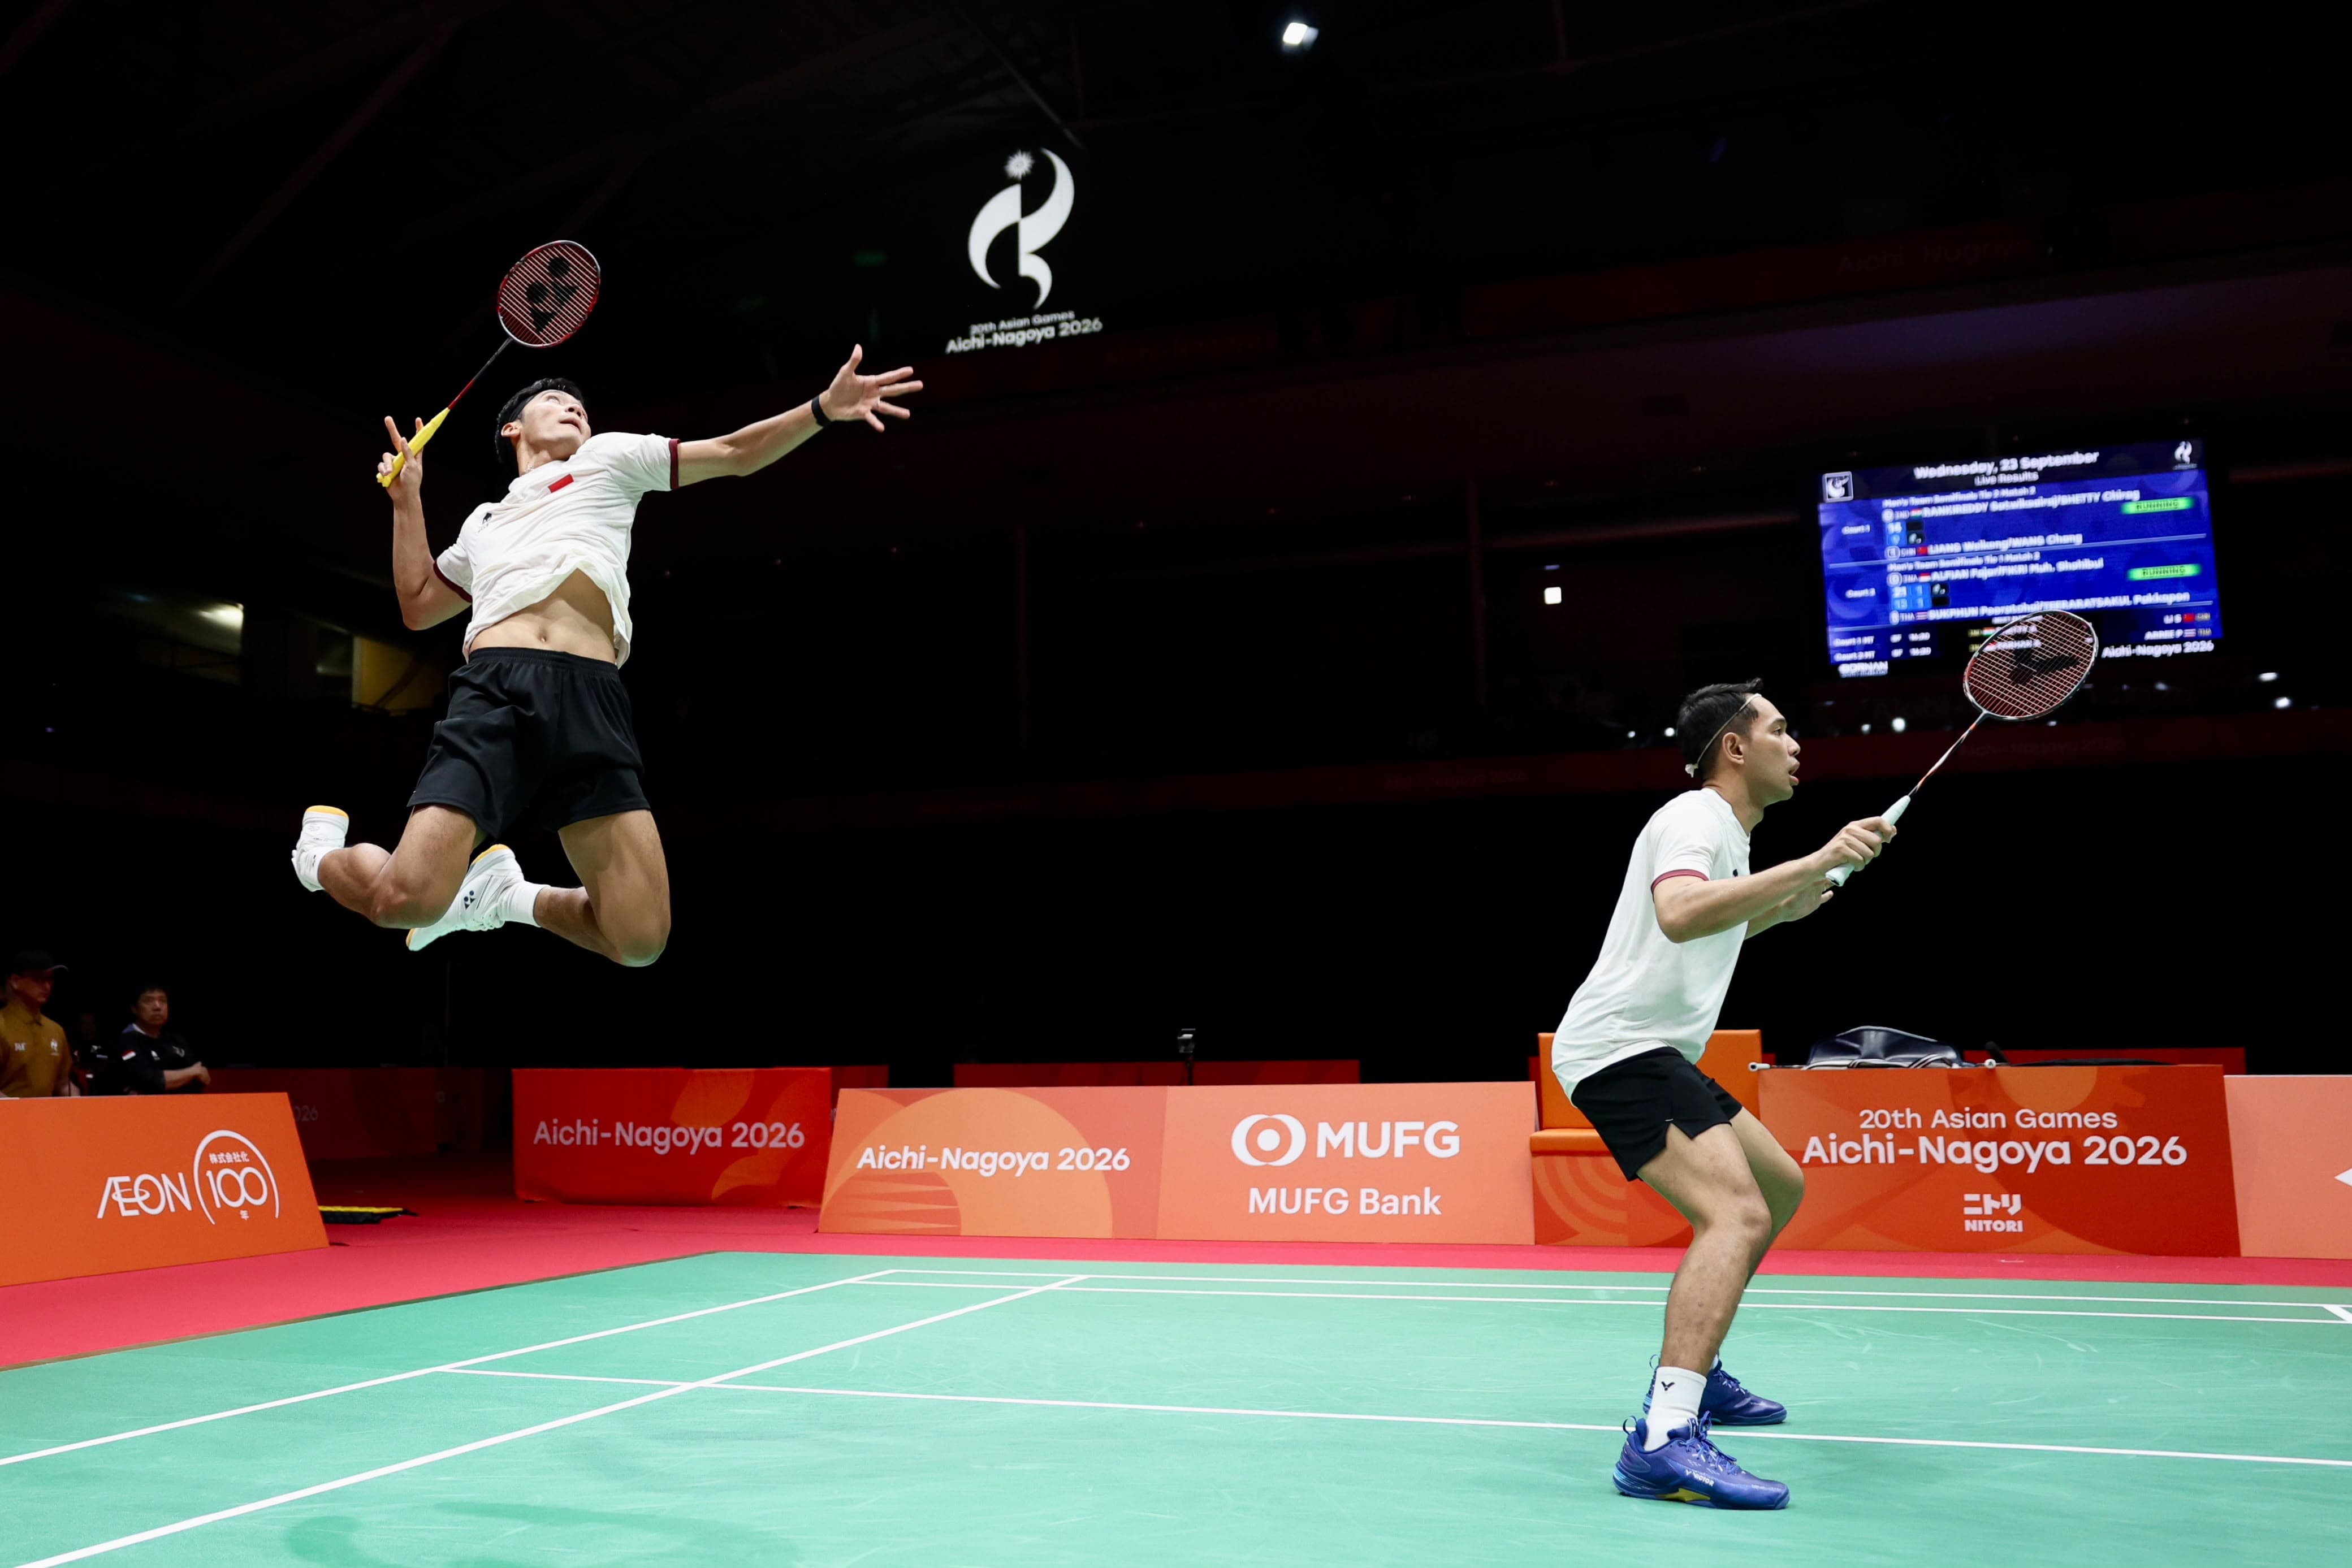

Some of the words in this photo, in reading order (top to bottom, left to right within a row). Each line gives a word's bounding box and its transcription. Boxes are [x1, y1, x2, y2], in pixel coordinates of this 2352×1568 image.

[998, 317, 1030, 332] Asian
[1031, 310, 1075, 326] Games
[945, 326, 1055, 354] Aichi-Nagoya
[1058, 317, 1103, 336] 2026
[1913, 461, 1998, 479] Wednesday,
[1999, 458, 2018, 472] 23
[2019, 451, 2099, 471] September
[1974, 474, 1996, 486] Live
[1998, 471, 2039, 484] Results
[2101, 643, 2182, 658] Aichi-Nagoya
[2183, 640, 2214, 653] 2026
[294, 1105, 318, 1121] 026
[1859, 1108, 1922, 1129] 20th
[1931, 1108, 2007, 1129] Asian
[2015, 1109, 2118, 1129] Games
[533, 1119, 723, 1155] Aichi-Nagoya
[731, 1121, 805, 1149] 2026
[1316, 1120, 1460, 1158] MUFG
[857, 1145, 1049, 1177] Aichi-Nagoya
[1057, 1147, 1130, 1172] 2026
[1802, 1134, 2070, 1174] Aichi-Nagoya
[2083, 1136, 2187, 1166] 2026
[206, 1166, 268, 1209] 100
[1248, 1188, 1350, 1215] MUFG
[1359, 1187, 1442, 1215] Bank
[1964, 1193, 2022, 1216] ニトリ
[1964, 1219, 2024, 1233] NITORI
